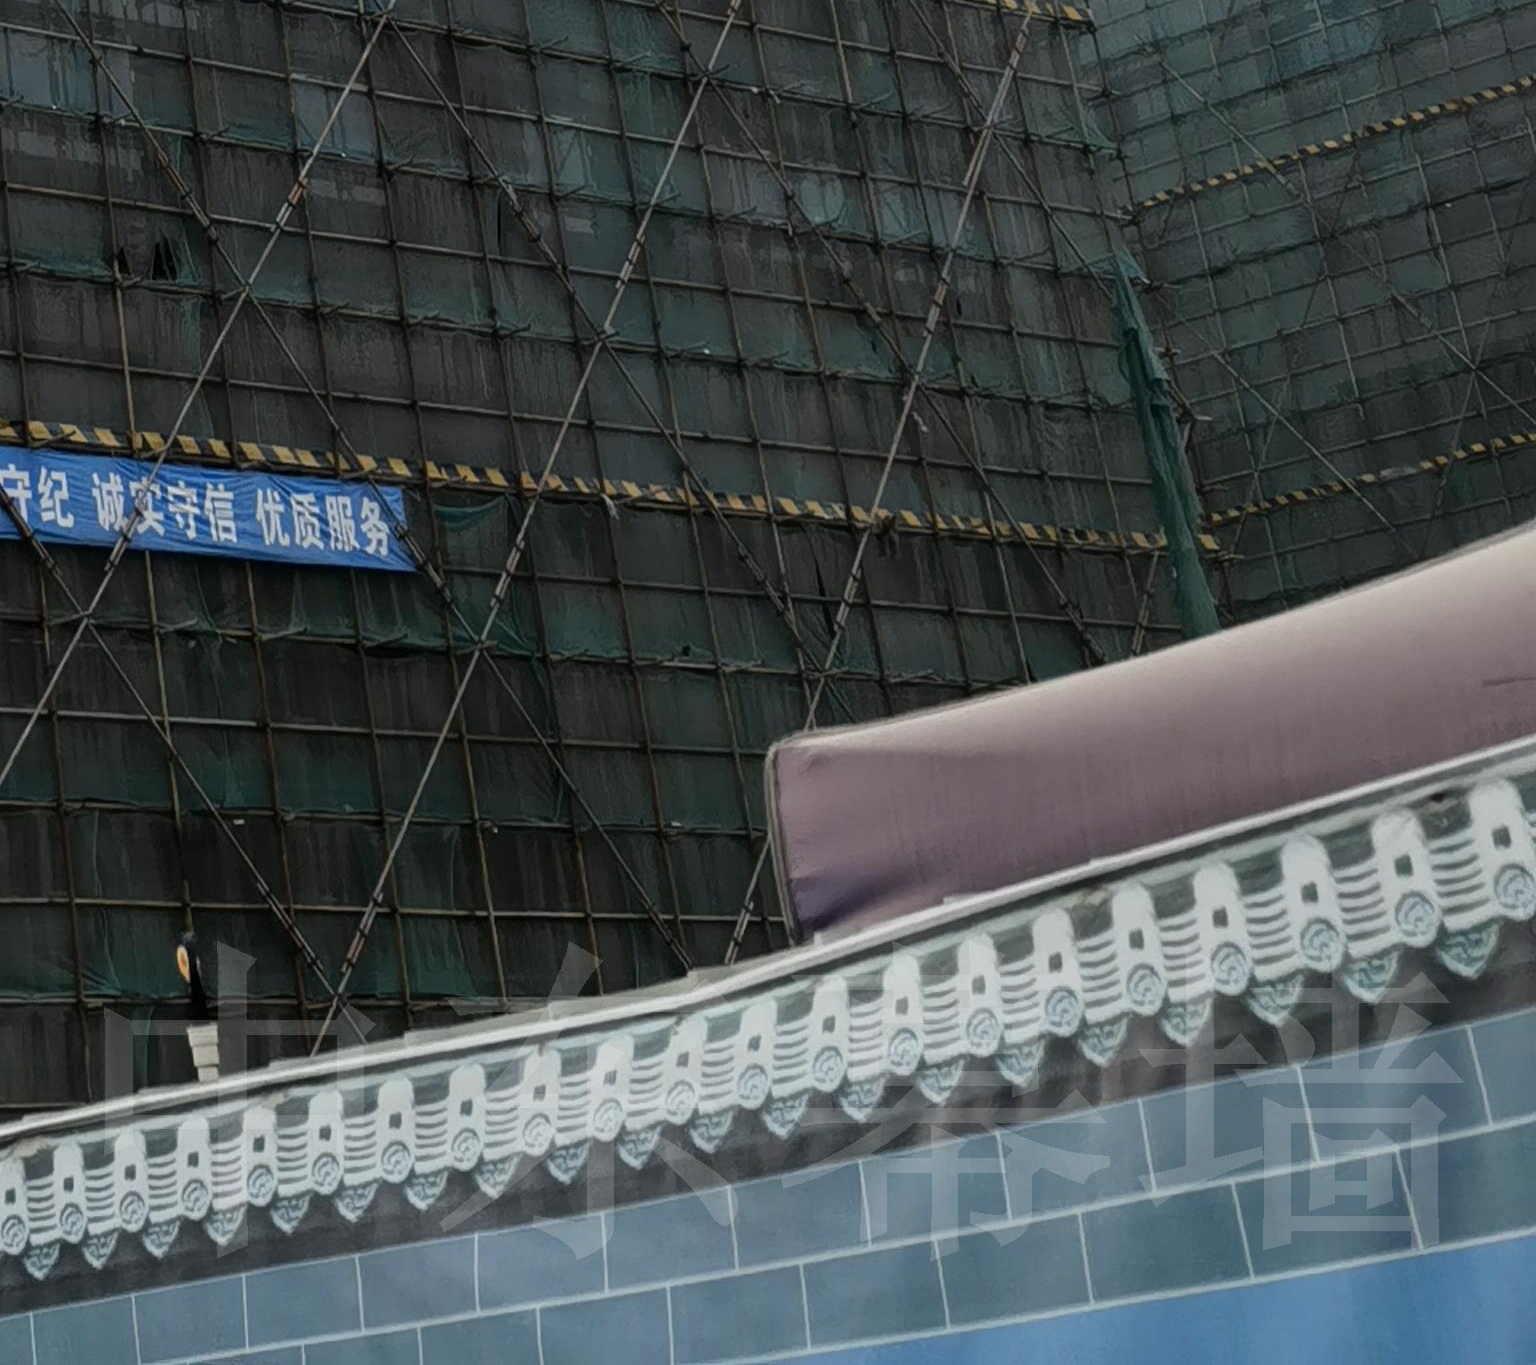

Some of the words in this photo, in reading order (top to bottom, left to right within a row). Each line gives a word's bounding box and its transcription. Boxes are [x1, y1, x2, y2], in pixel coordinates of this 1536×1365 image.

[91, 471, 238, 545] 诚实守信
[255, 487, 391, 557] 优质服务
